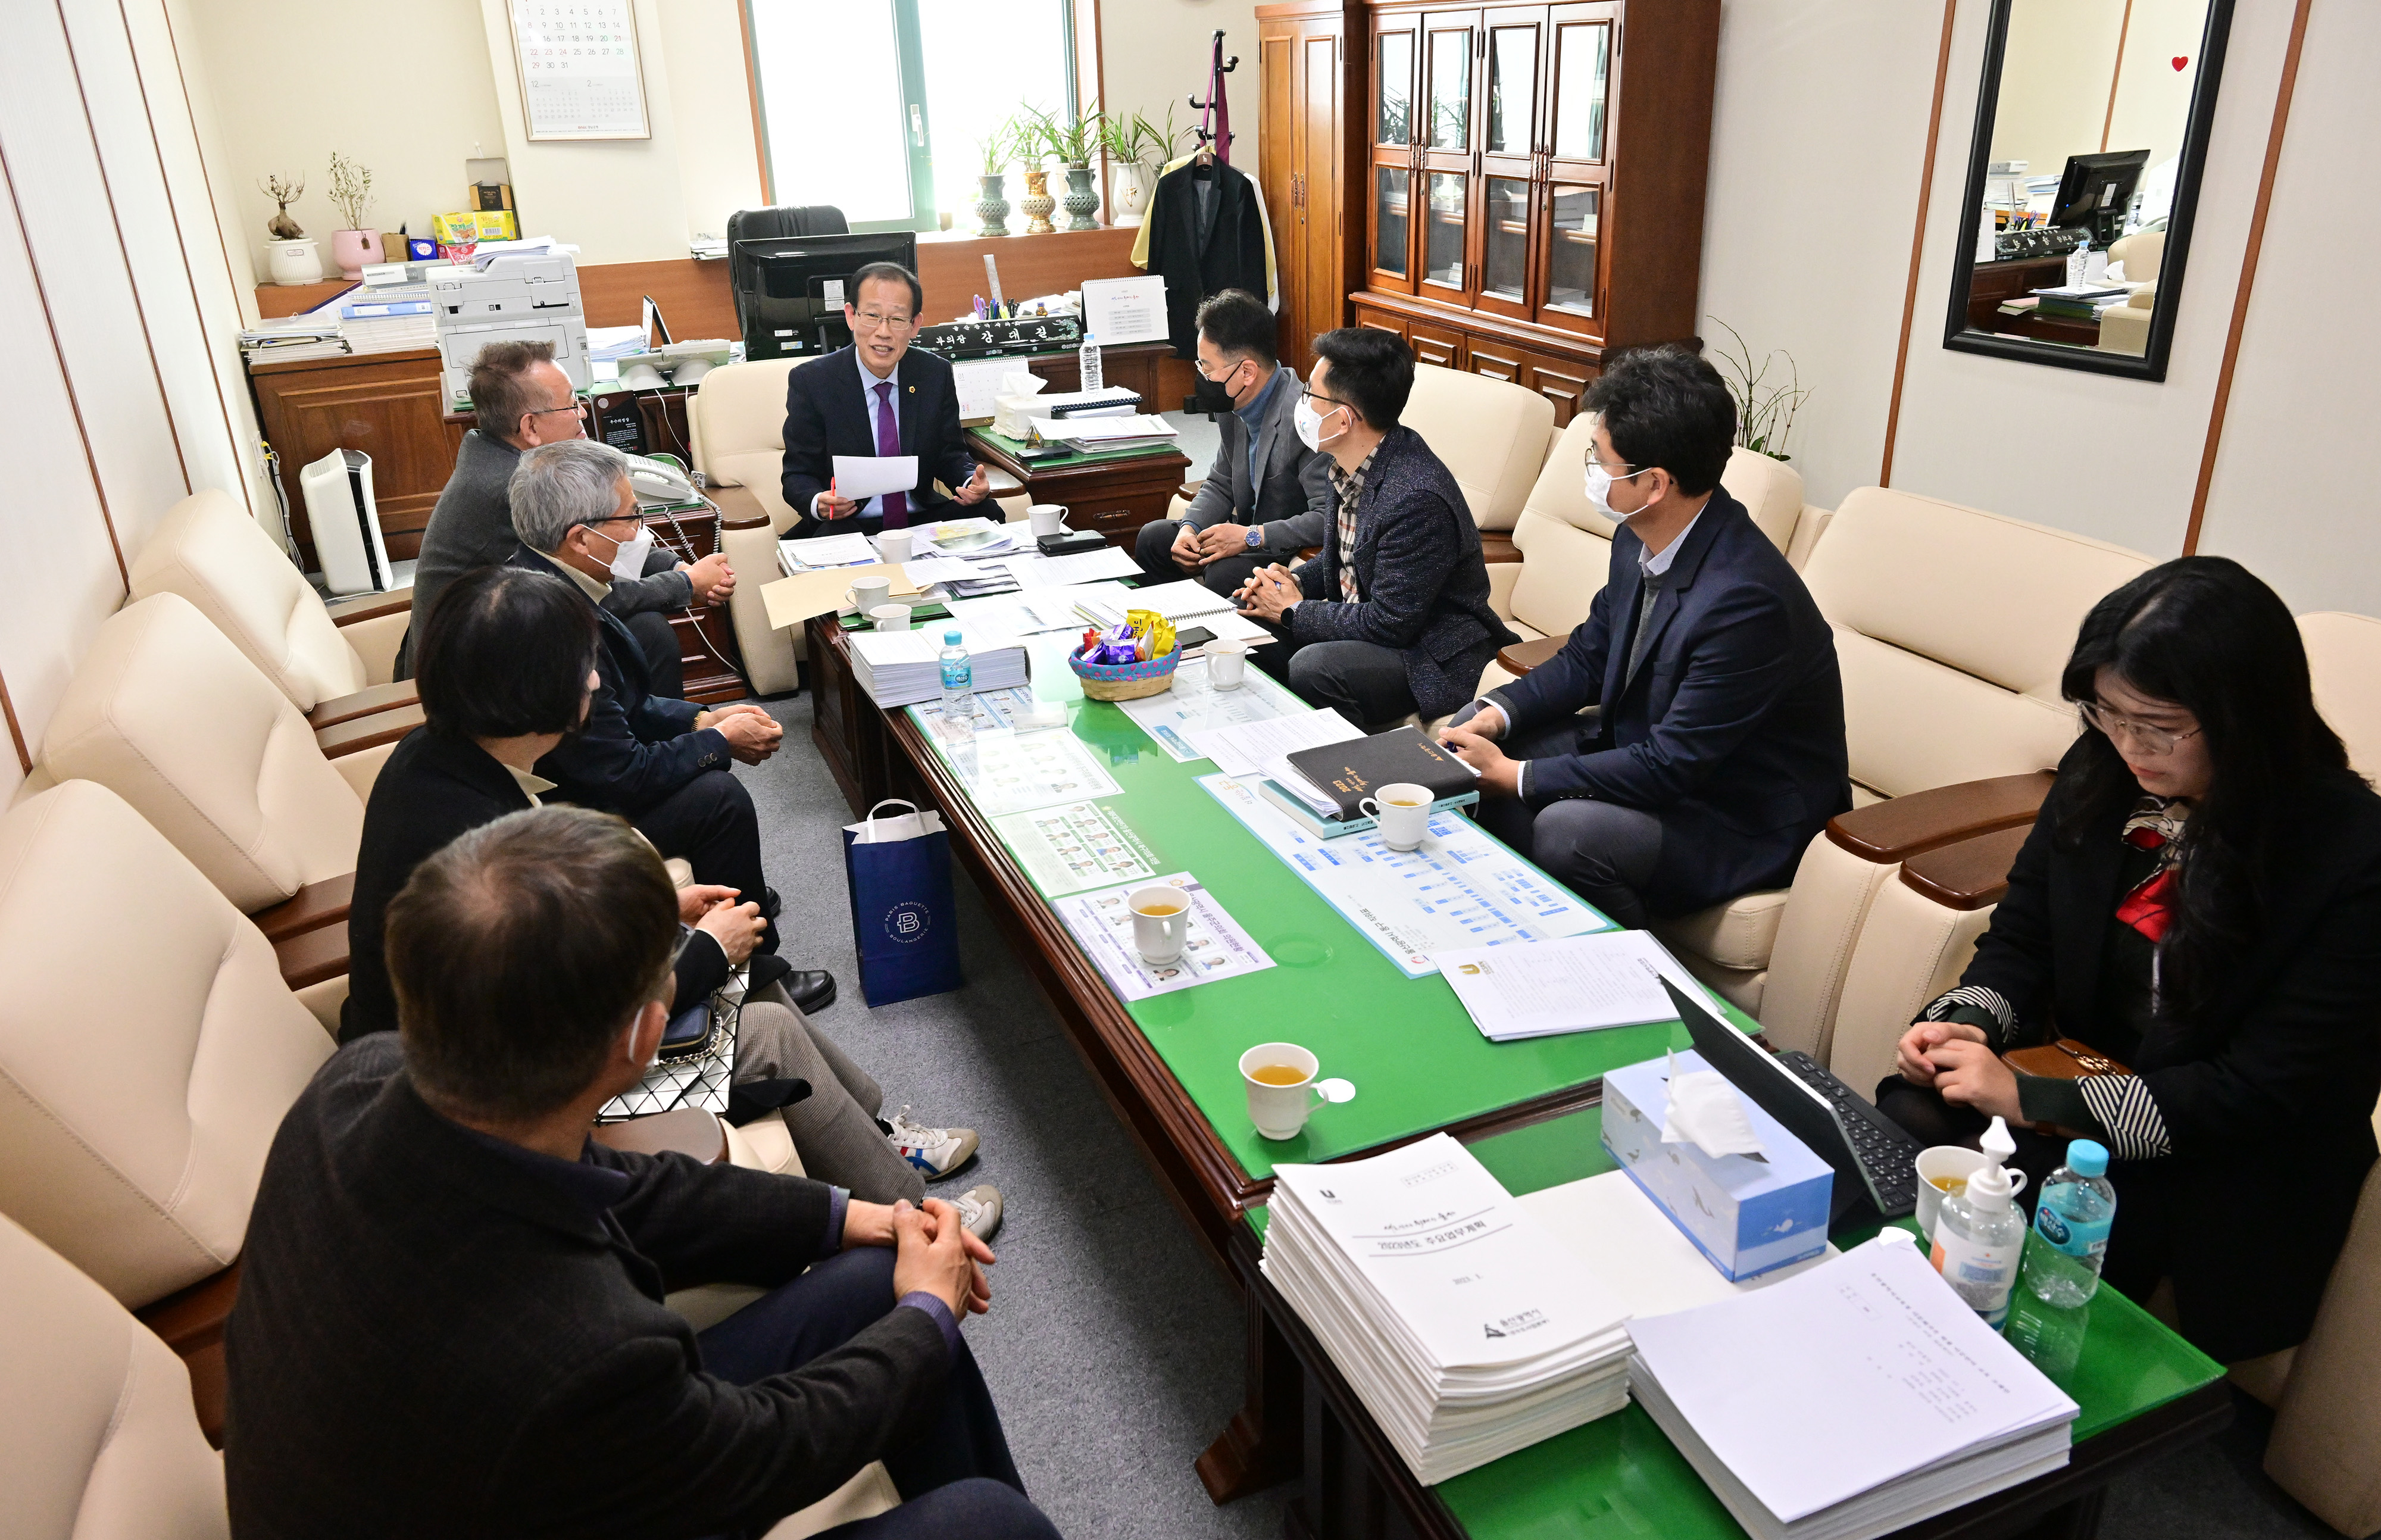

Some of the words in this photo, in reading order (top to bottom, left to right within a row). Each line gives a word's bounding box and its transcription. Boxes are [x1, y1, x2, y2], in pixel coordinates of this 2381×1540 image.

[936, 335, 967, 346] 부의장
[1218, 780, 1239, 791] 동구
[1333, 780, 1352, 793] 2023
[885, 905, 898, 921] PARIS
[900, 901, 929, 914] BAGUETTE
[1360, 908, 1377, 921] 직위표
[1202, 913, 1228, 935] 울주군의회
[1223, 933, 1245, 952] 의원현황
[1374, 922, 1390, 932] 동구
[889, 927, 929, 944] BOULANGERIE
[1385, 931, 1416, 955] 울산광역시
[1426, 1220, 1488, 1245] 주요업무계획
